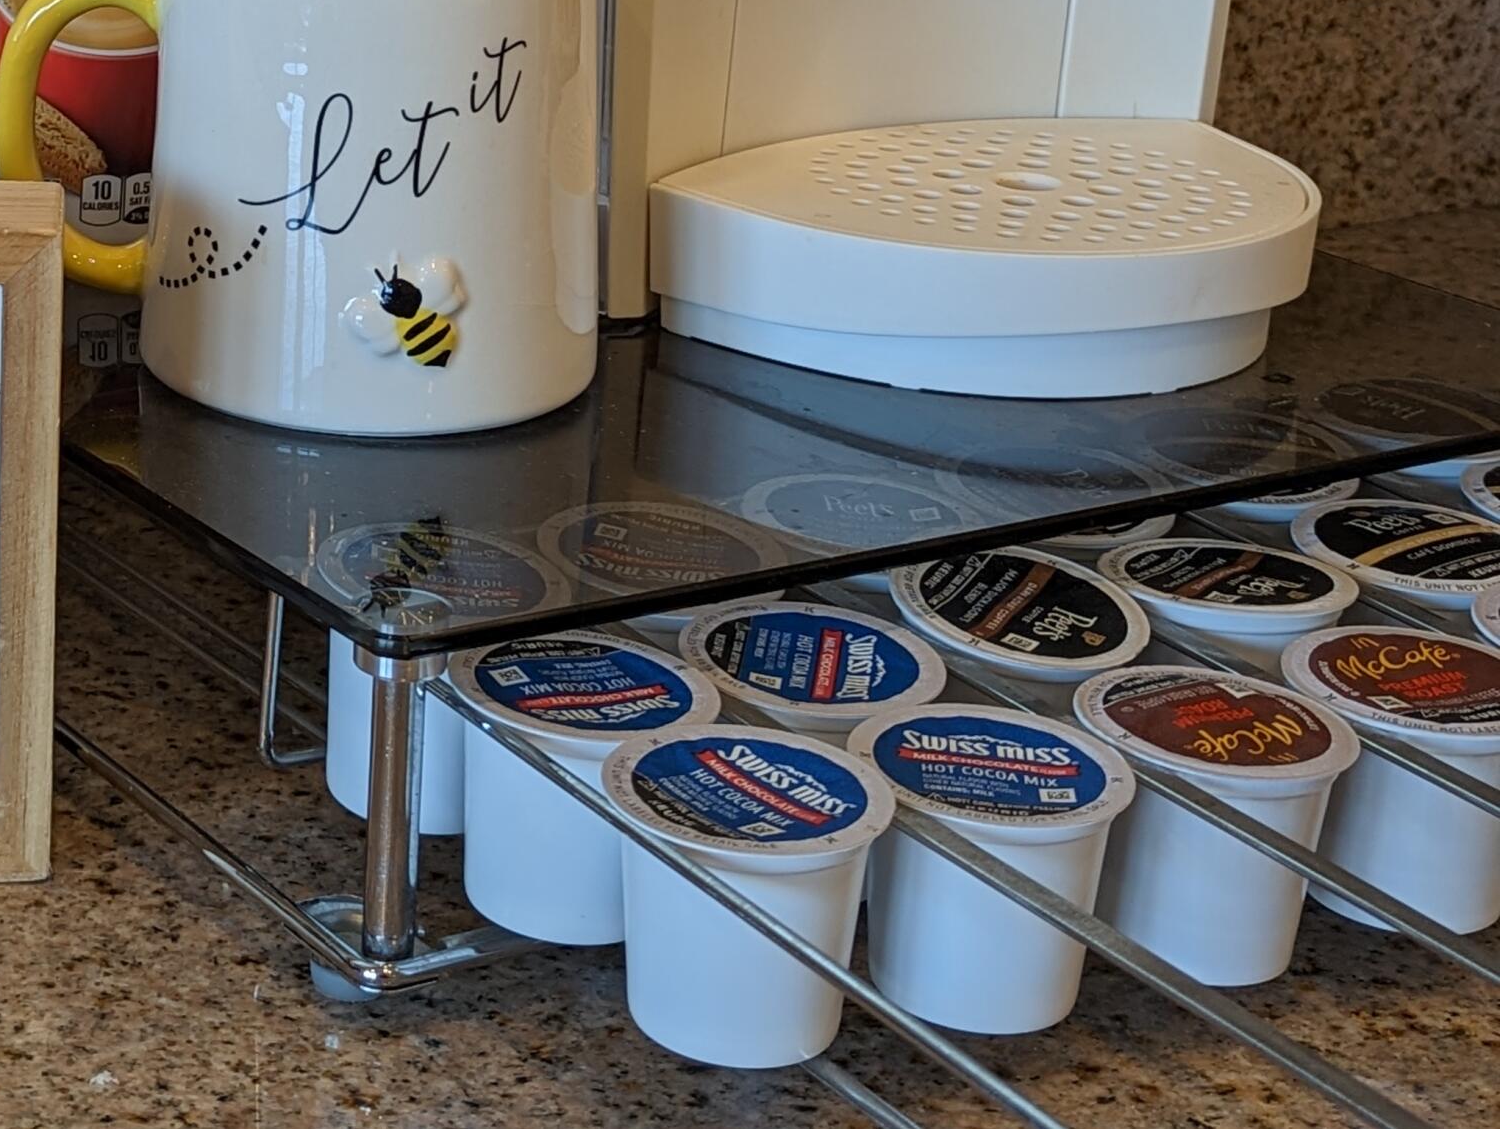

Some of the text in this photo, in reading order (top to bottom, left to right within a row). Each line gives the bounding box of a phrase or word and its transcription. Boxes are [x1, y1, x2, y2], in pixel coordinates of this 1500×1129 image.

[470, 37, 526, 122] it
[238, 93, 459, 235] Let
[92, 180, 111, 200] 10
[83, 202, 119, 211] CALORIES
[1425, 582, 1451, 591] UNIT
[1033, 606, 1098, 641] Peet's
[796, 634, 814, 653] HOT
[1336, 640, 1450, 680] McCafé
[520, 677, 636, 695] HOT COCOA MIX
[1379, 671, 1468, 692] PREMIUM
[1404, 682, 1467, 698] ROAST
[1192, 715, 1303, 761] McCafé
[913, 752, 948, 761] MILK
[950, 756, 1037, 770] CHOCOLATE
[921, 763, 1058, 787] HOT COCOA MIX
[707, 759, 736, 780] MILK
[735, 775, 800, 814] CHOCOLATE
[973, 789, 995, 797] MILK
[690, 768, 724, 788] HOT
[718, 787, 764, 815] COCOA
[760, 811, 795, 827] MIX
